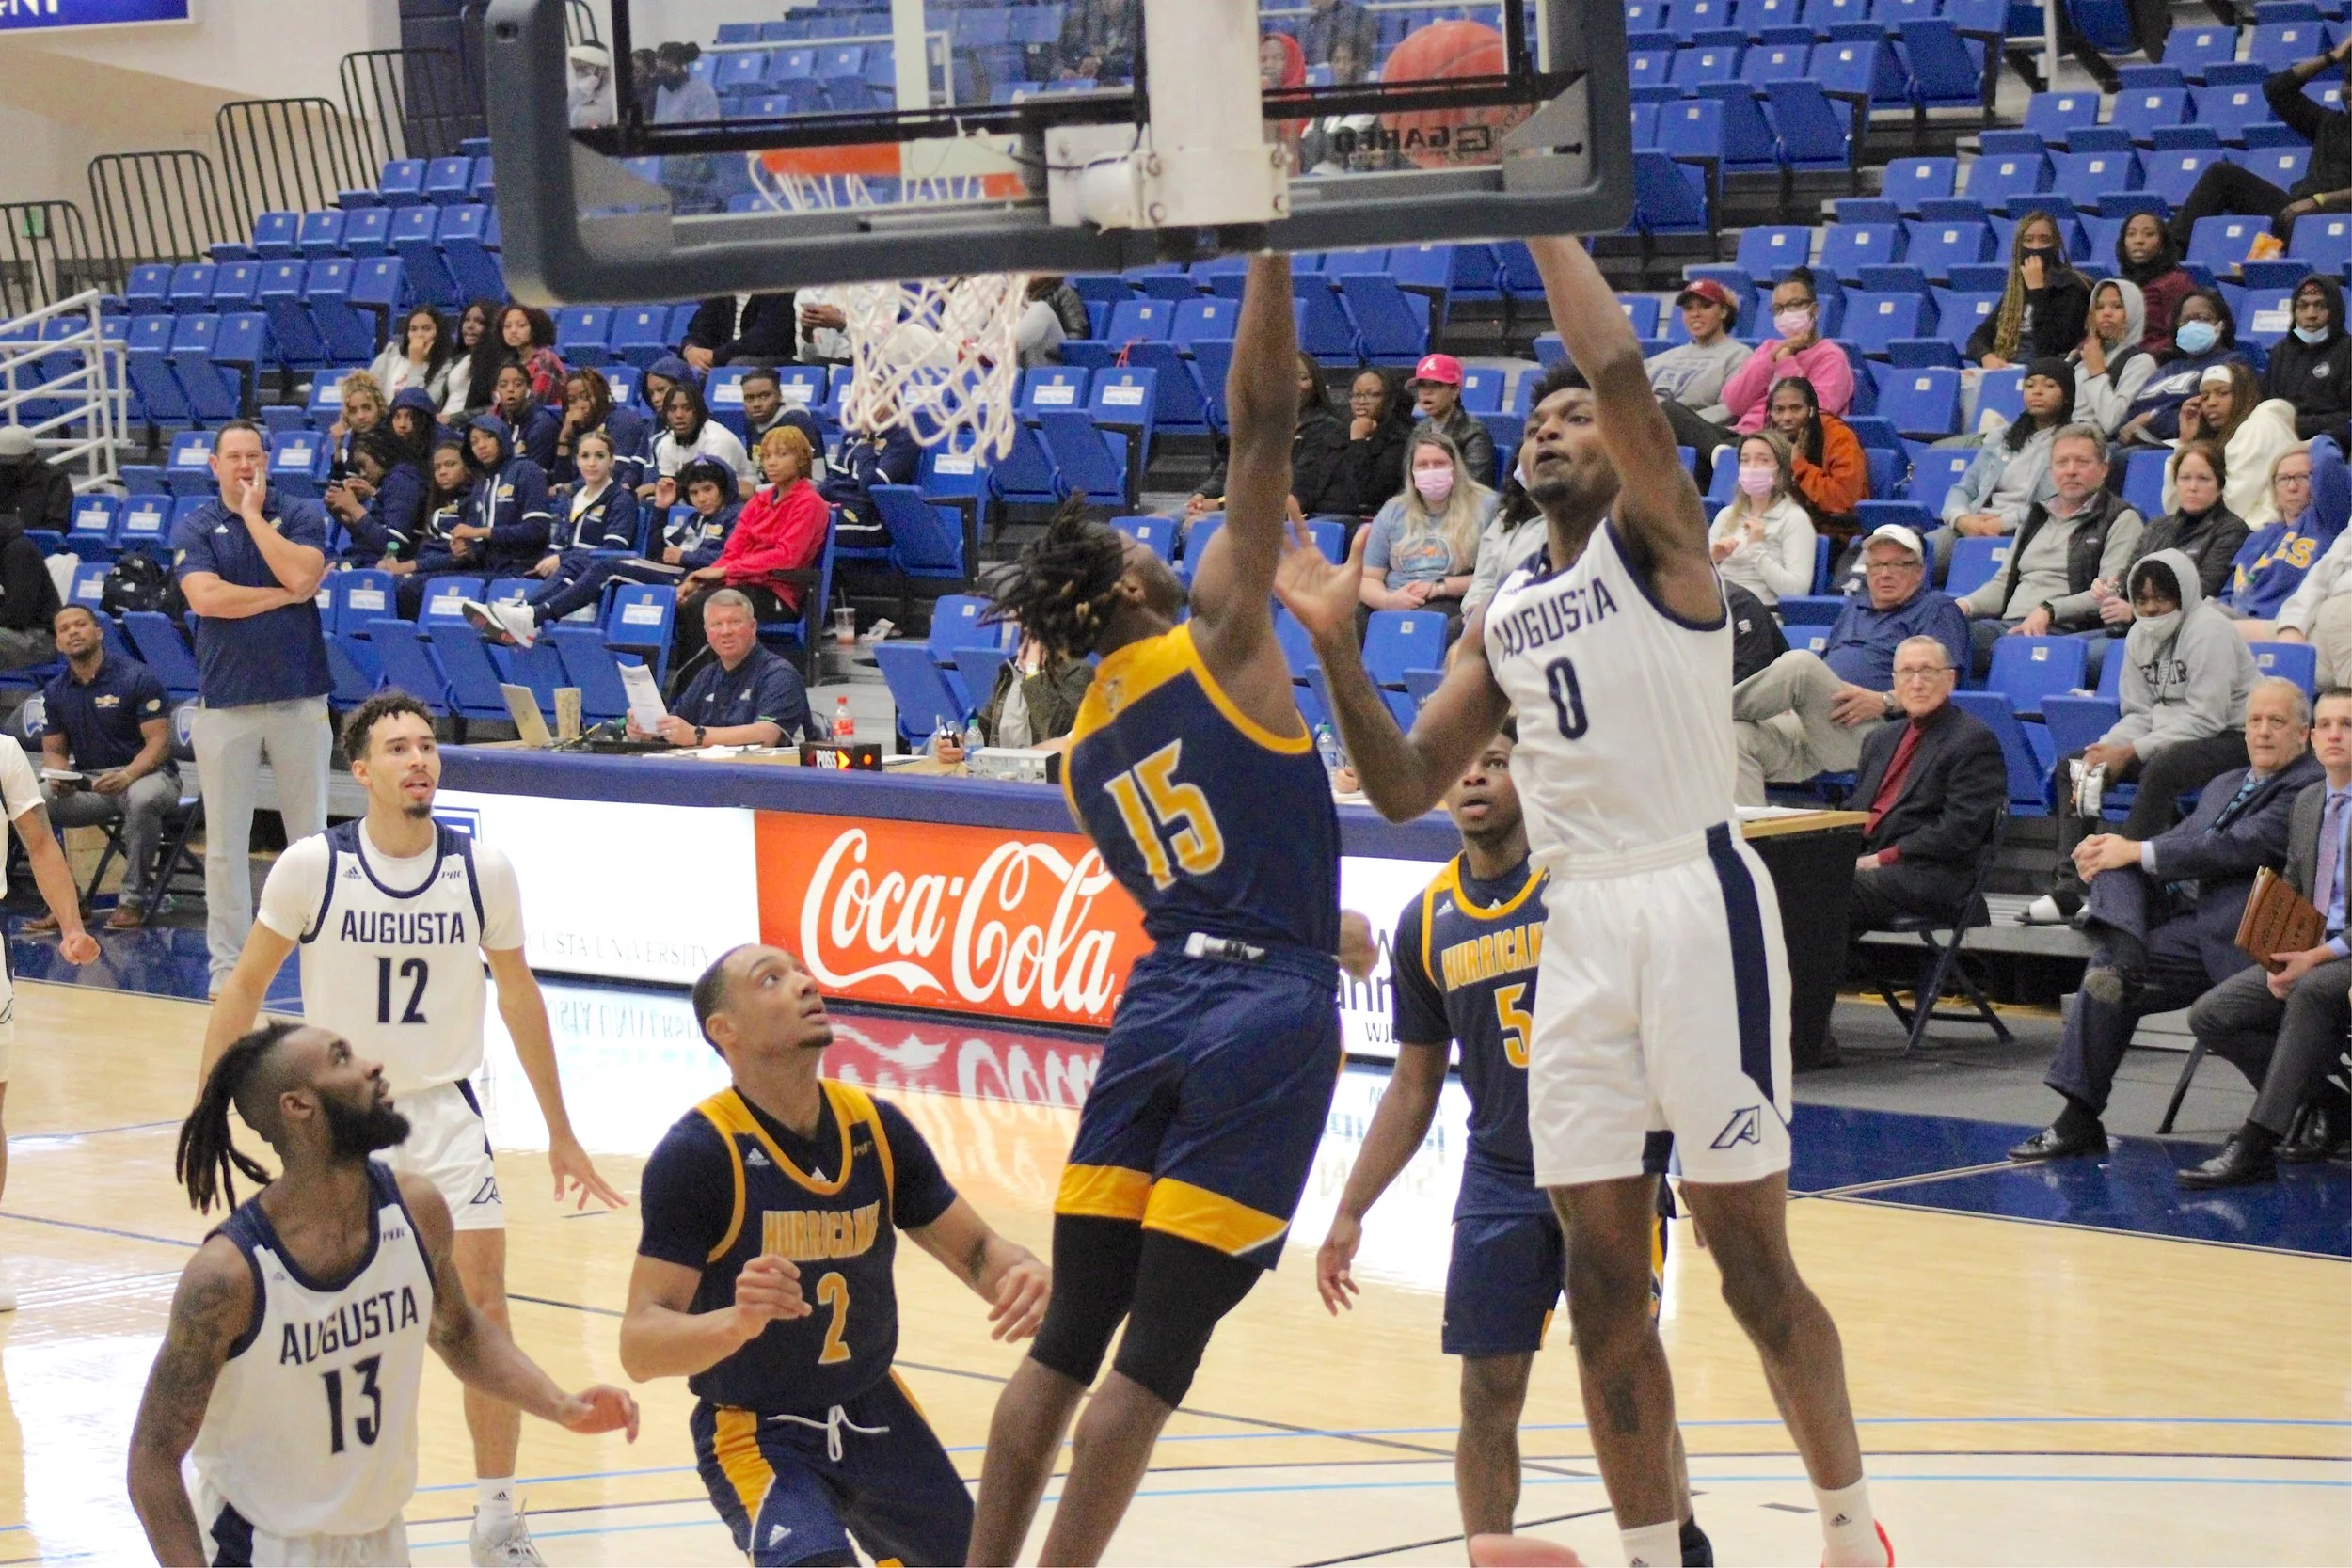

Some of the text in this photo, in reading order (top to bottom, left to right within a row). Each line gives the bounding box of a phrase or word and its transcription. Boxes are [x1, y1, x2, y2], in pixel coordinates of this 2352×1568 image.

[1492, 576, 1618, 662] AUGUSTA
[1545, 657, 1588, 740] 0
[1104, 737, 1224, 891] 15
[341, 910, 465, 944] AUGUSTA
[595, 936, 710, 969] UNIVERSITY
[801, 828, 1117, 1014] Coca-Cola
[1441, 921, 1545, 992] HURRICAN
[375, 957, 429, 1023] 12
[1494, 982, 1533, 1069] 5
[280, 1285, 418, 1364] AUGUSTA
[817, 1271, 851, 1364] 2
[321, 1353, 383, 1455] 13
